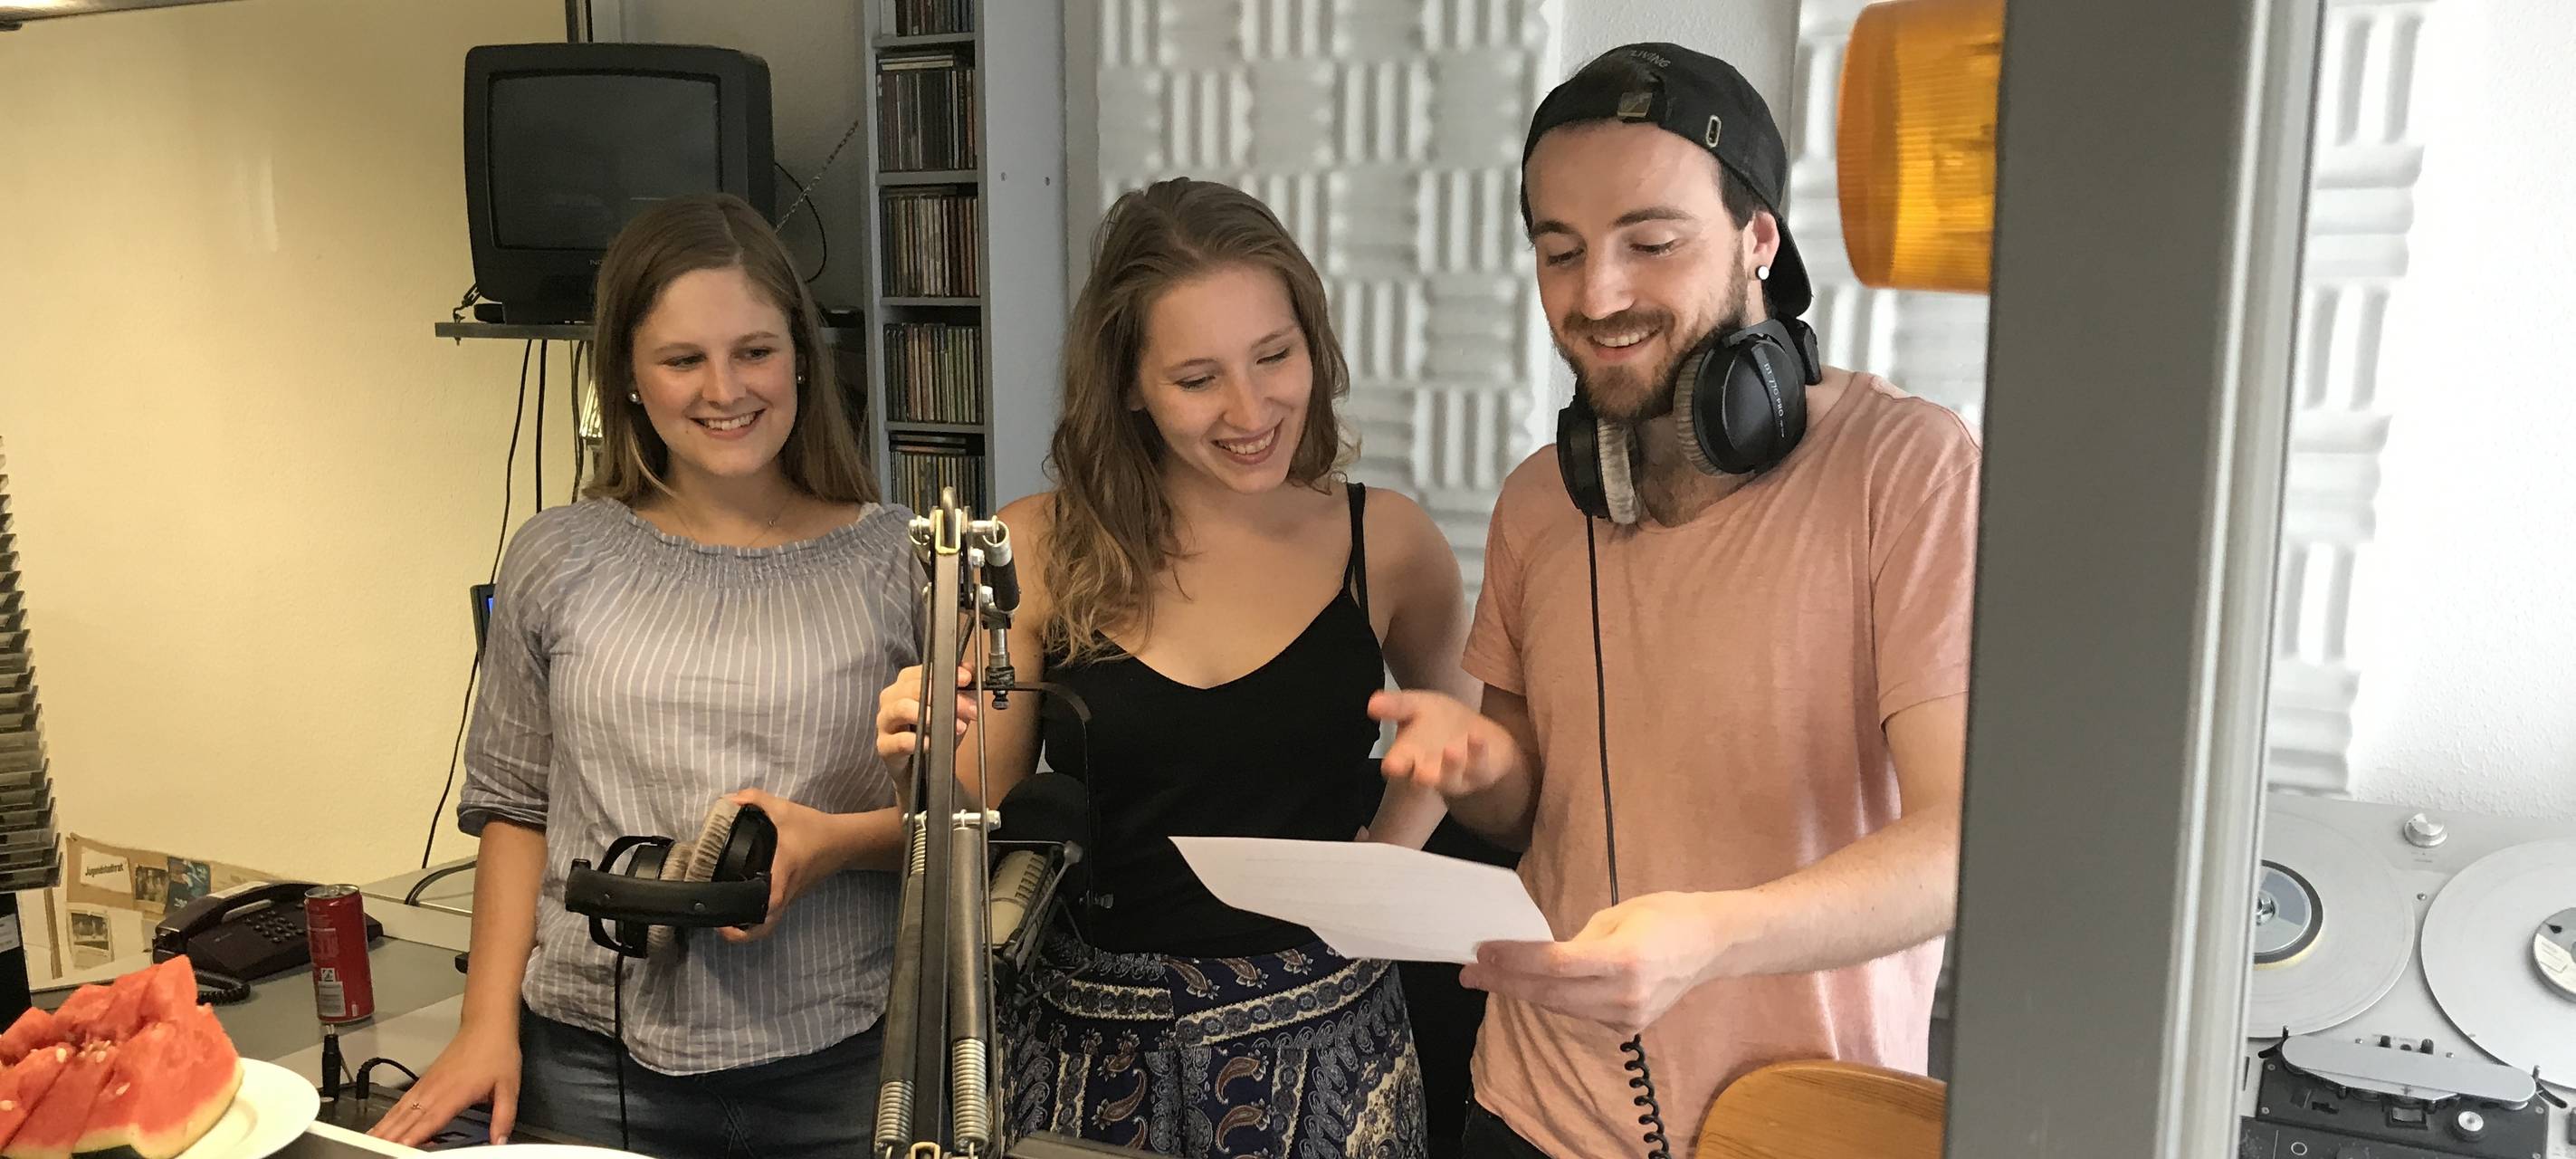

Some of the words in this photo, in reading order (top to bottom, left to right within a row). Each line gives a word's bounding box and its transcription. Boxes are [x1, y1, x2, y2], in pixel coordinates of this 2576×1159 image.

[1629, 50, 1671, 68] LIVING
[1763, 362, 1773, 376] DT
[1768, 378, 1779, 396] 770
[1776, 398, 1784, 417] PRO
